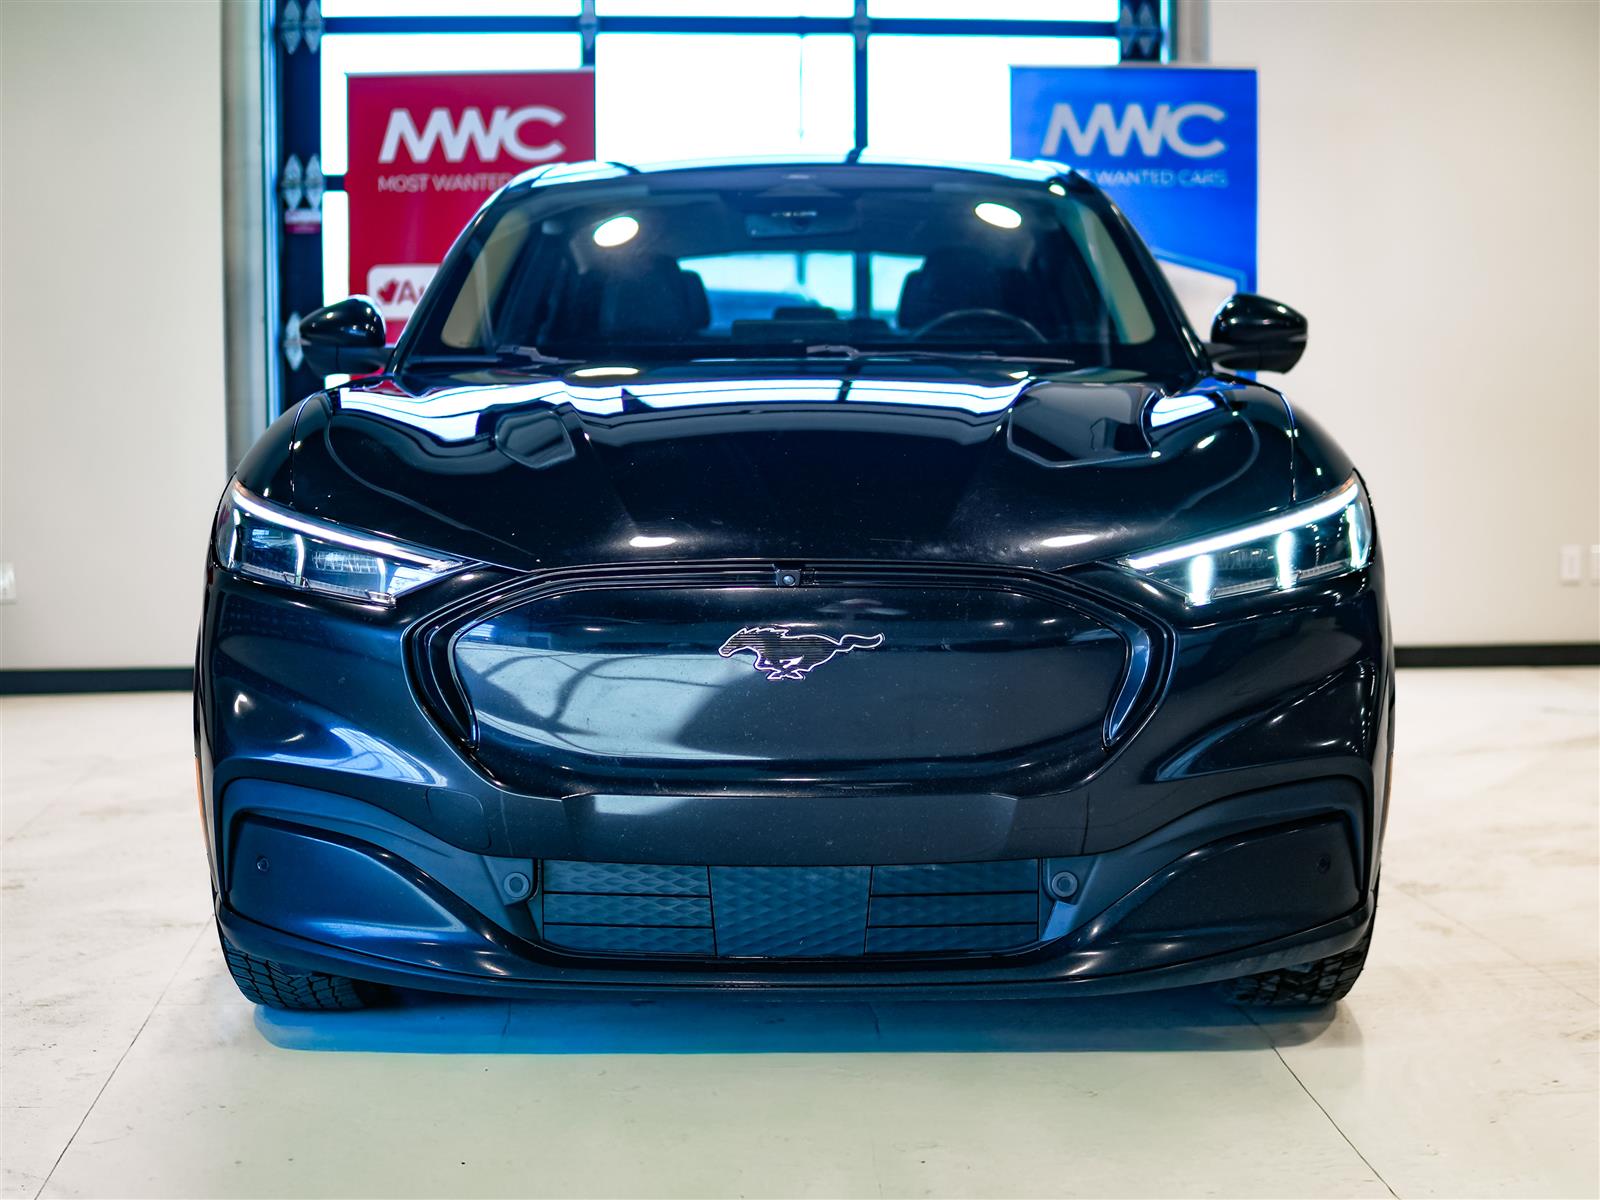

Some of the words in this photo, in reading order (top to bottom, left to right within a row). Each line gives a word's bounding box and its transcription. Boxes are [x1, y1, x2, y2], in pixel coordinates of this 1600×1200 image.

[378, 106, 566, 163] MWC
[1040, 103, 1226, 158] MWC
[377, 173, 429, 192] MOST
[1096, 170, 1174, 187] WANTED
[1178, 169, 1228, 188] CARS
